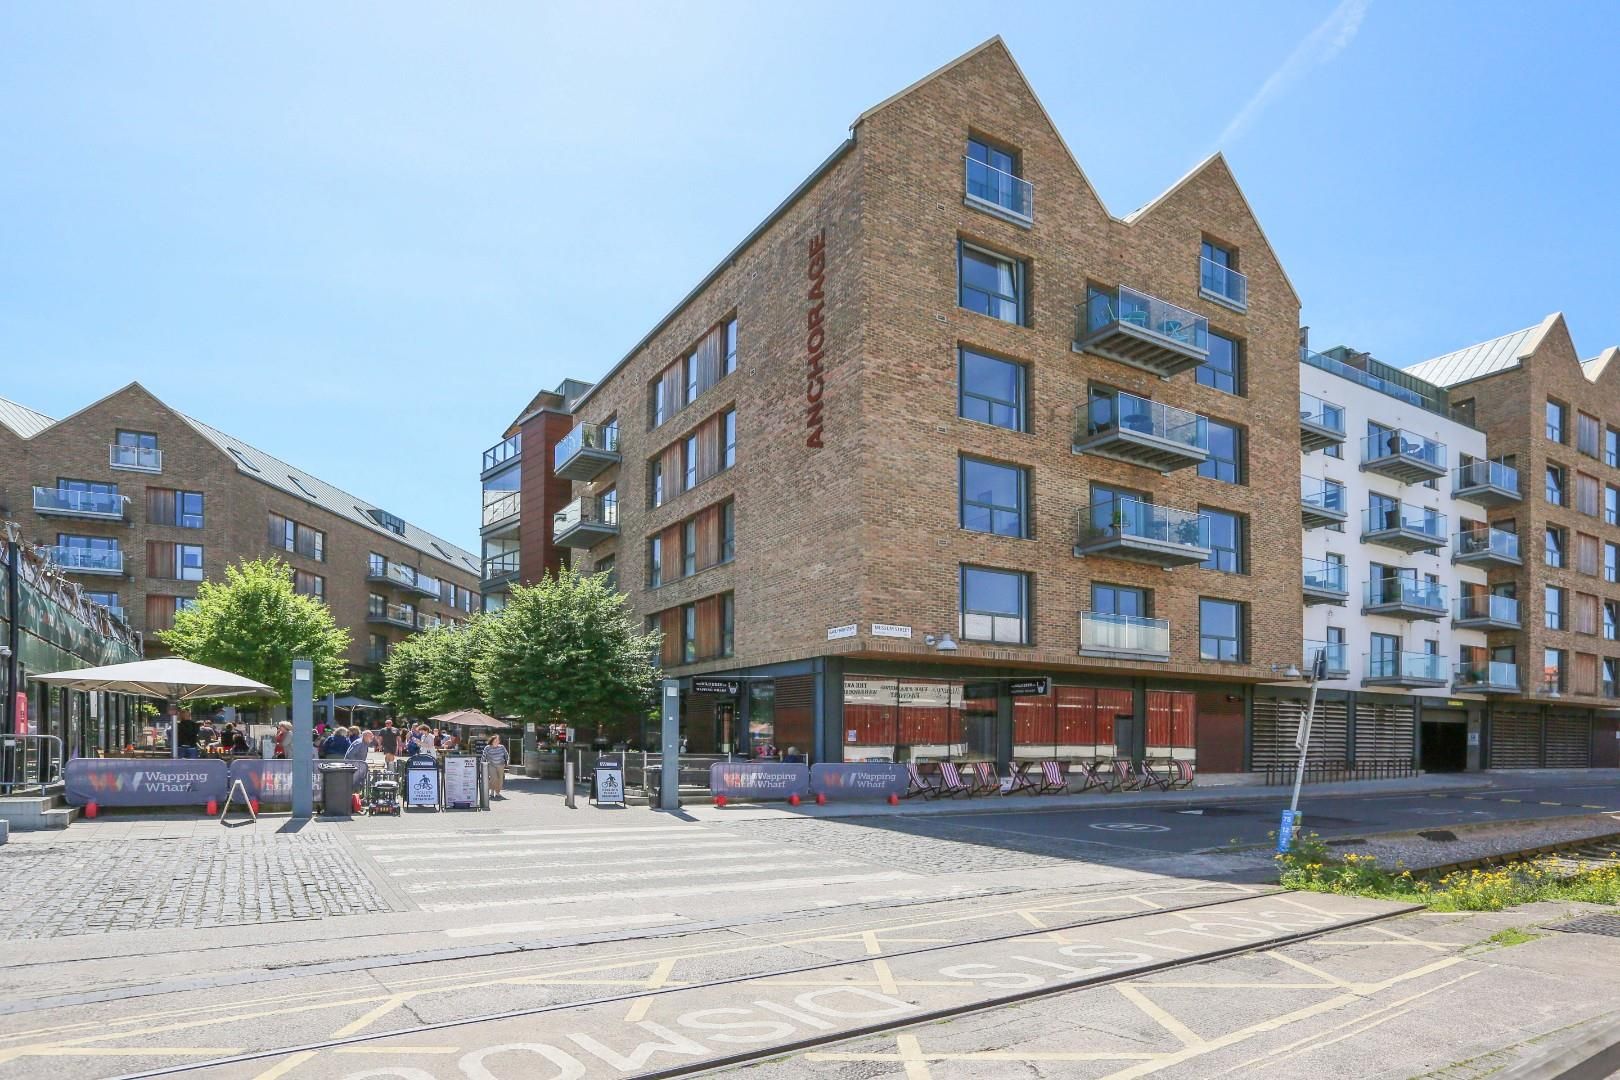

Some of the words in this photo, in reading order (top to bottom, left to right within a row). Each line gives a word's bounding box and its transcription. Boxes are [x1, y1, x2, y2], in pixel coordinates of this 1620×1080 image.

[807, 228, 825, 448] ANCHORAGE
[146, 771, 208, 784] Wapping
[757, 772, 797, 782] Wapping
[857, 772, 897, 782] Wapping
[146, 782, 192, 792] Wharf
